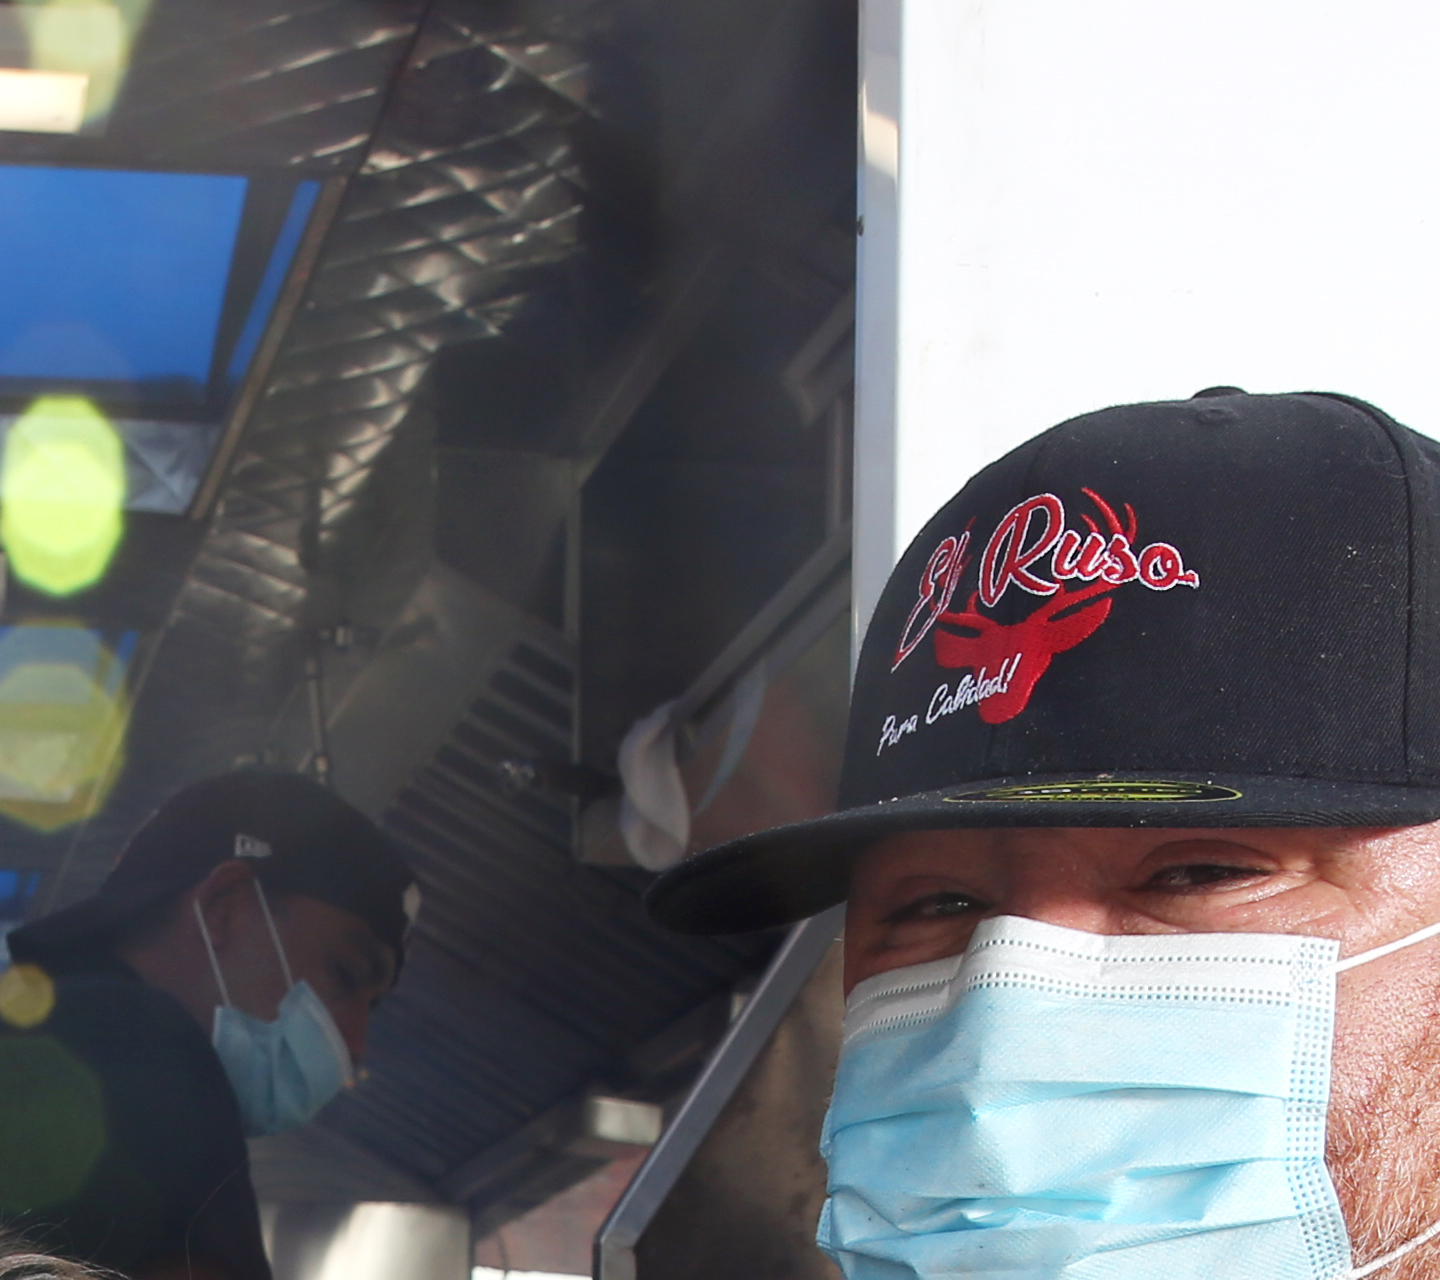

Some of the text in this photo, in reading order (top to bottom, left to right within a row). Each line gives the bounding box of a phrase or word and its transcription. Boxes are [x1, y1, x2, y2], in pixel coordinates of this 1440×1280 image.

[890, 492, 1201, 674] El Ruso
[876, 715, 918, 757] Pura
